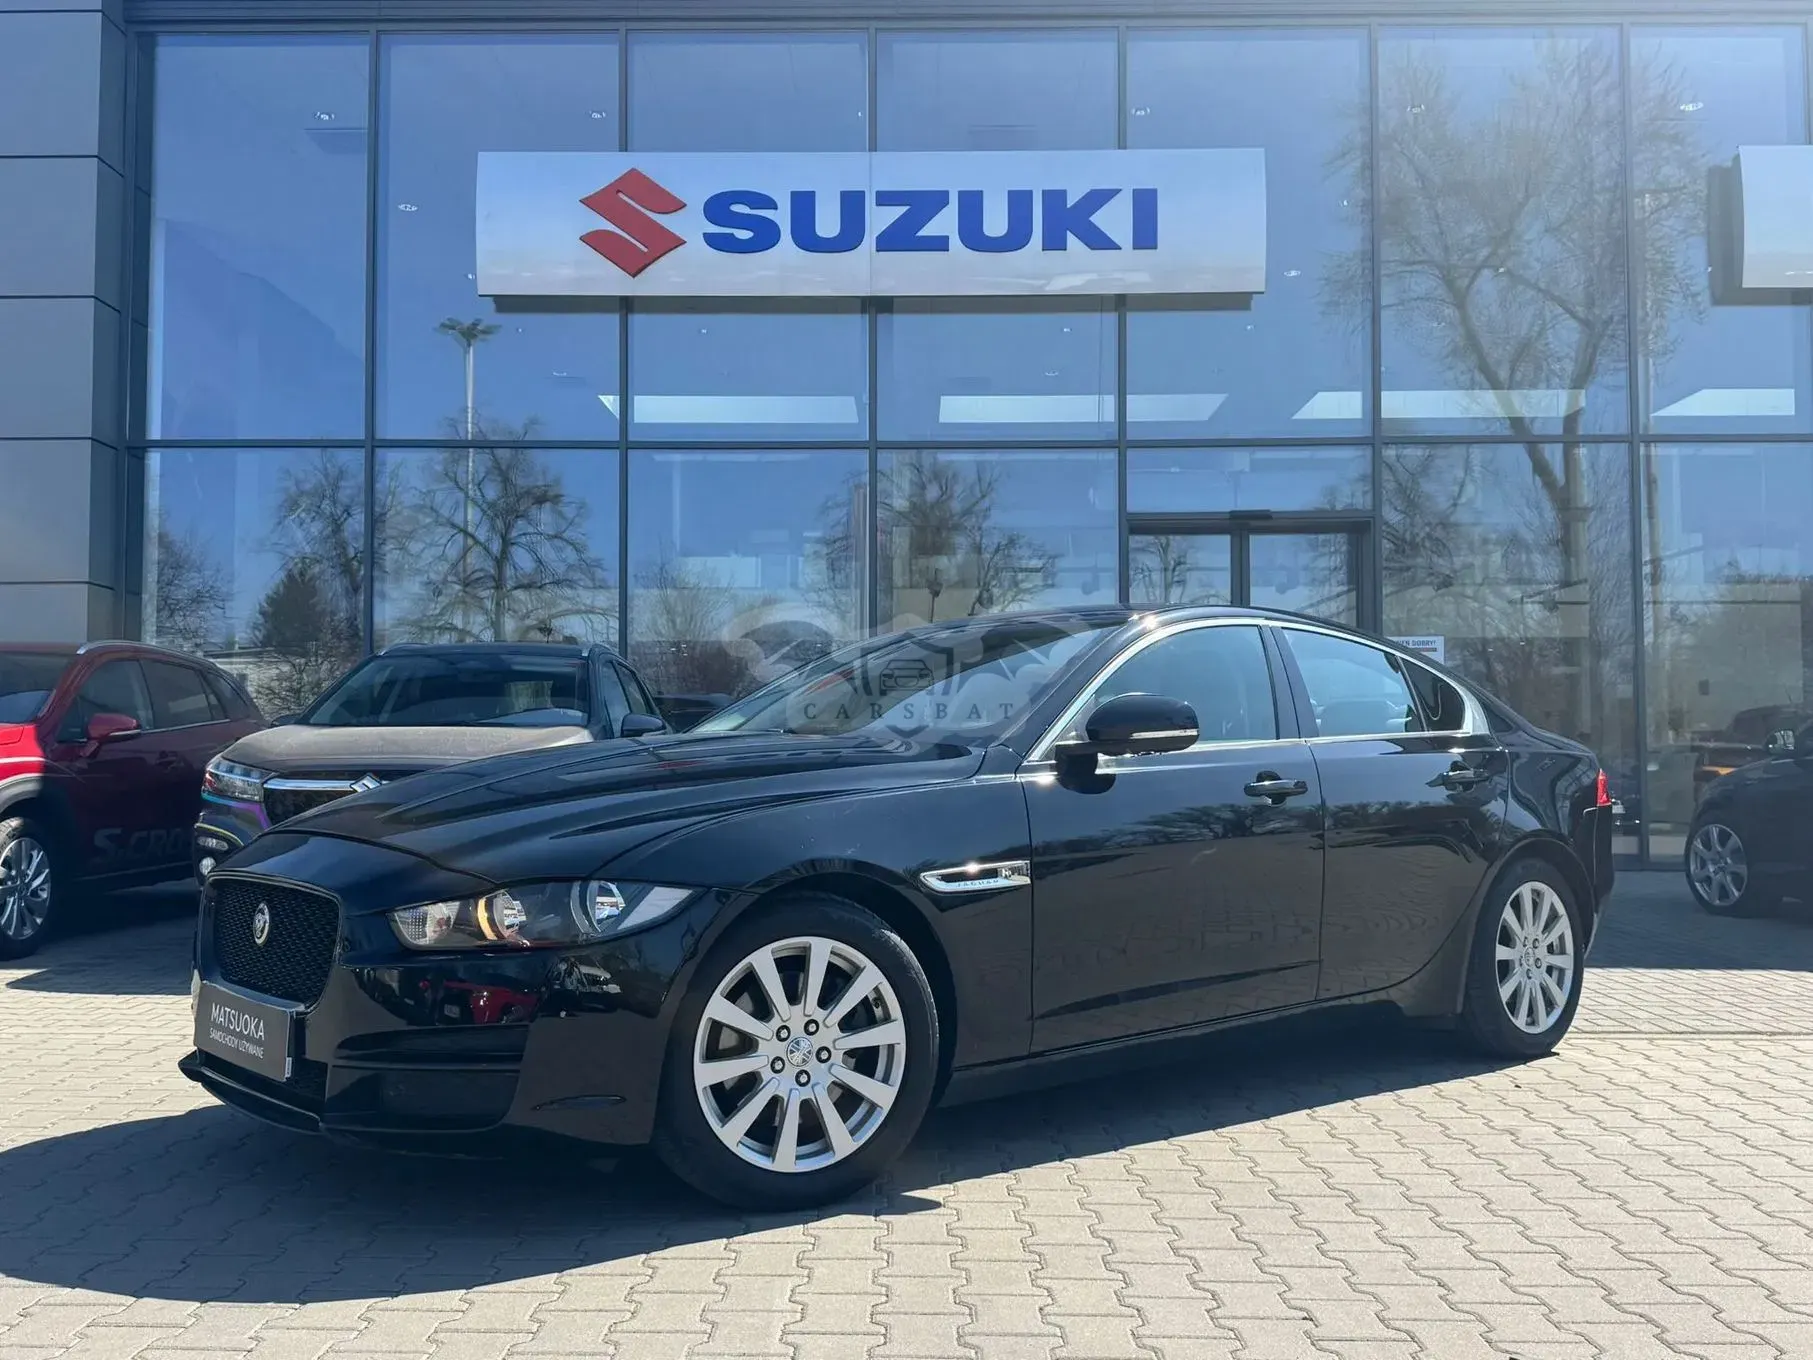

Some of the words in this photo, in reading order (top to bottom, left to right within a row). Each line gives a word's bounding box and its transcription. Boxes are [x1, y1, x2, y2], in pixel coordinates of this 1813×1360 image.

[702, 188, 1159, 254] SUZUKI
[209, 1027, 238, 1049] SAMOCHODY
[210, 1002, 265, 1040] MATSUOKA
